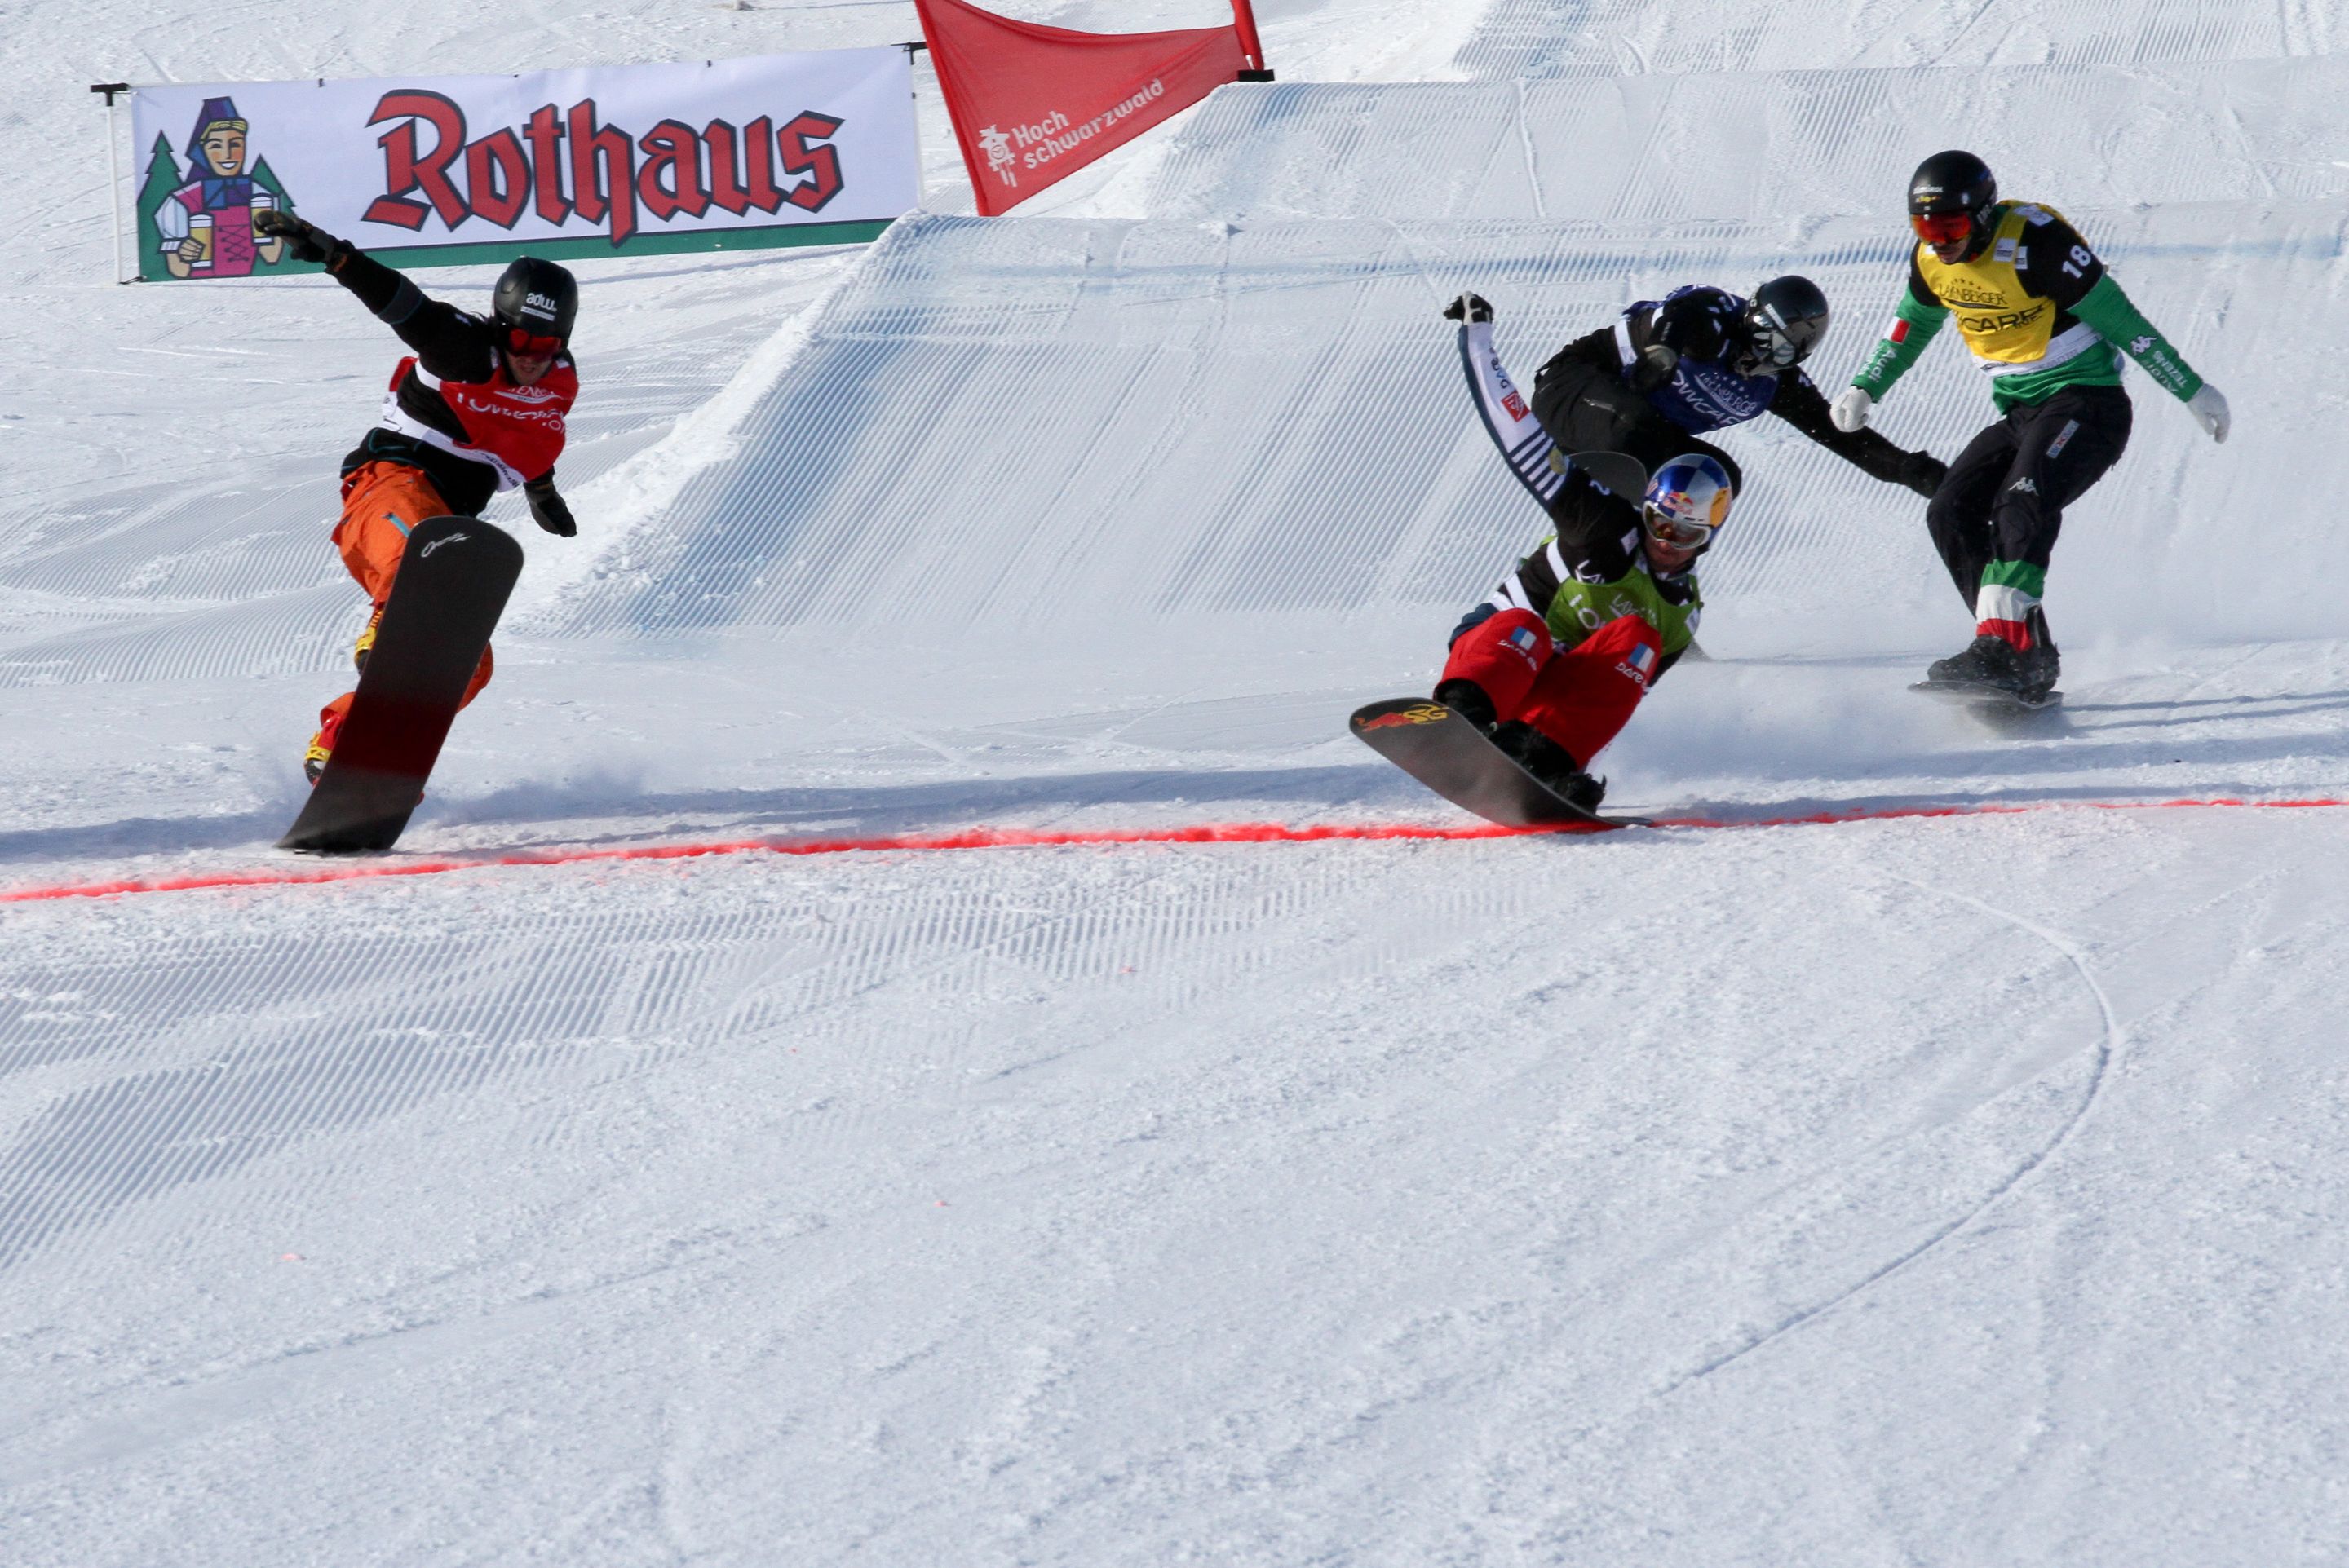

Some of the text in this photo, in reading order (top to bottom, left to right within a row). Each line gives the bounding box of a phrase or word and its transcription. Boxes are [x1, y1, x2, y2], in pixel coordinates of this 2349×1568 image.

[1011, 110, 1070, 148] Hoch
[1023, 77, 1166, 170] schwarzwald
[361, 88, 845, 249] Rothaus
[2061, 245, 2092, 279] 18
